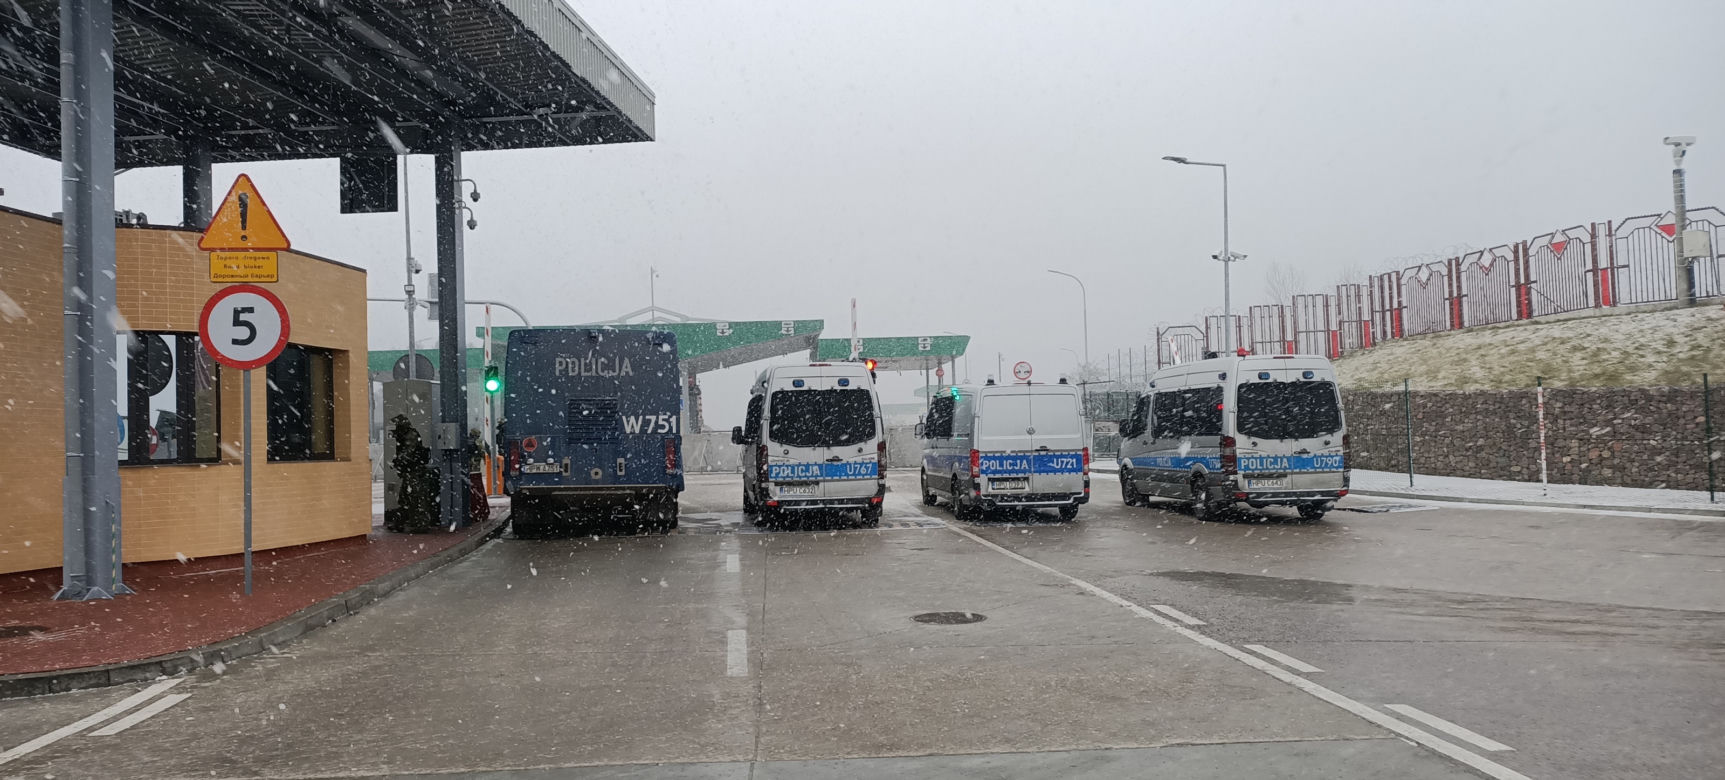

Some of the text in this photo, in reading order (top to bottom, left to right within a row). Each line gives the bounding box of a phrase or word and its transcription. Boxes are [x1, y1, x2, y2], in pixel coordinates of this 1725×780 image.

[231, 306, 257, 347] 5
[555, 357, 634, 377] POLICJA
[982, 458, 1077, 470] POLICJA U721
[1240, 456, 1339, 469] POLICJA U790
[771, 463, 872, 478] POLICJA U767
